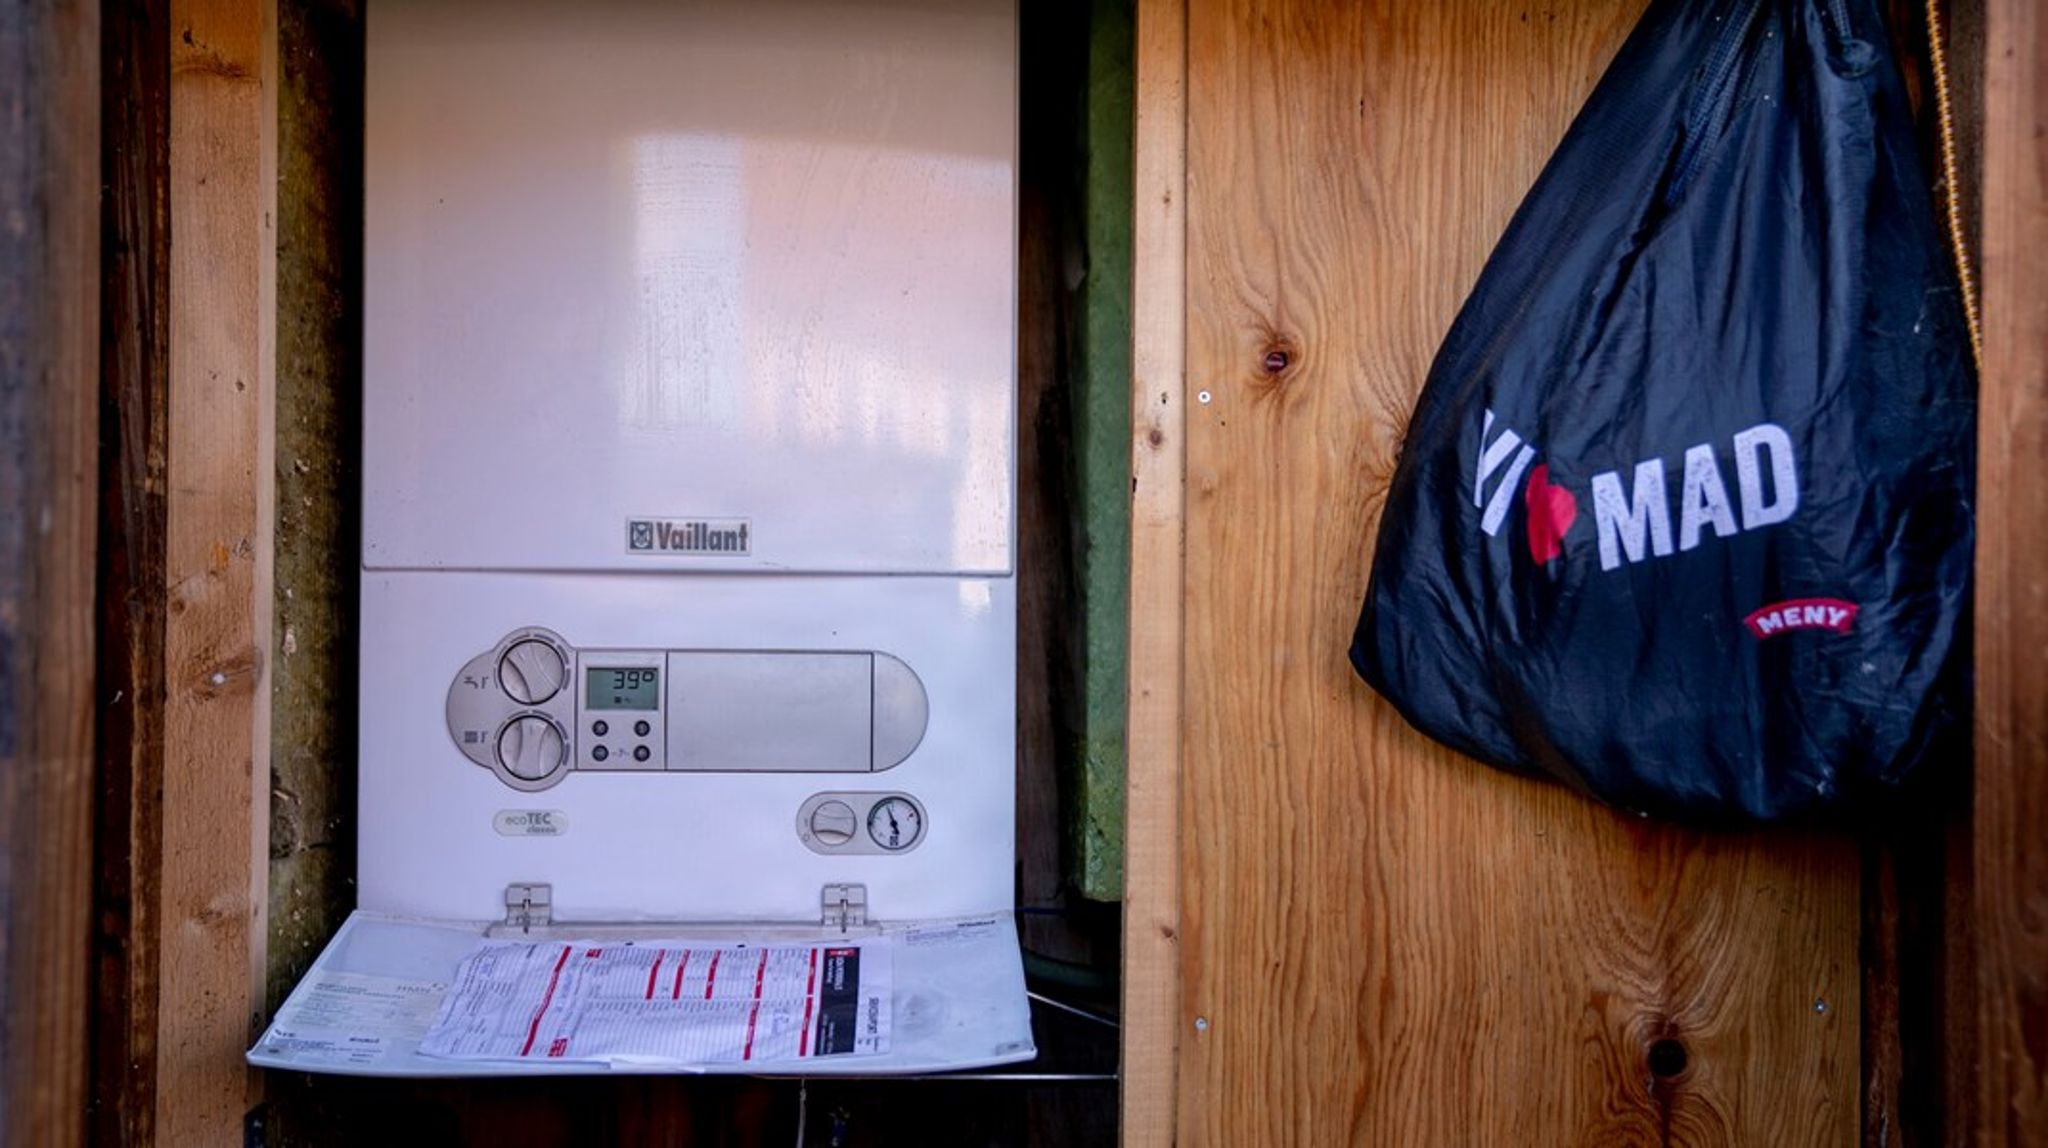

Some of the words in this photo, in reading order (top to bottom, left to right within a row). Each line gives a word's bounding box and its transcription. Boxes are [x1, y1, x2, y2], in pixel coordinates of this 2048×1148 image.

[1591, 423, 1800, 572] MAD
[656, 521, 748, 552] Vaillant
[1756, 604, 1849, 634] MENY
[504, 812, 552, 826] ecoTEC
